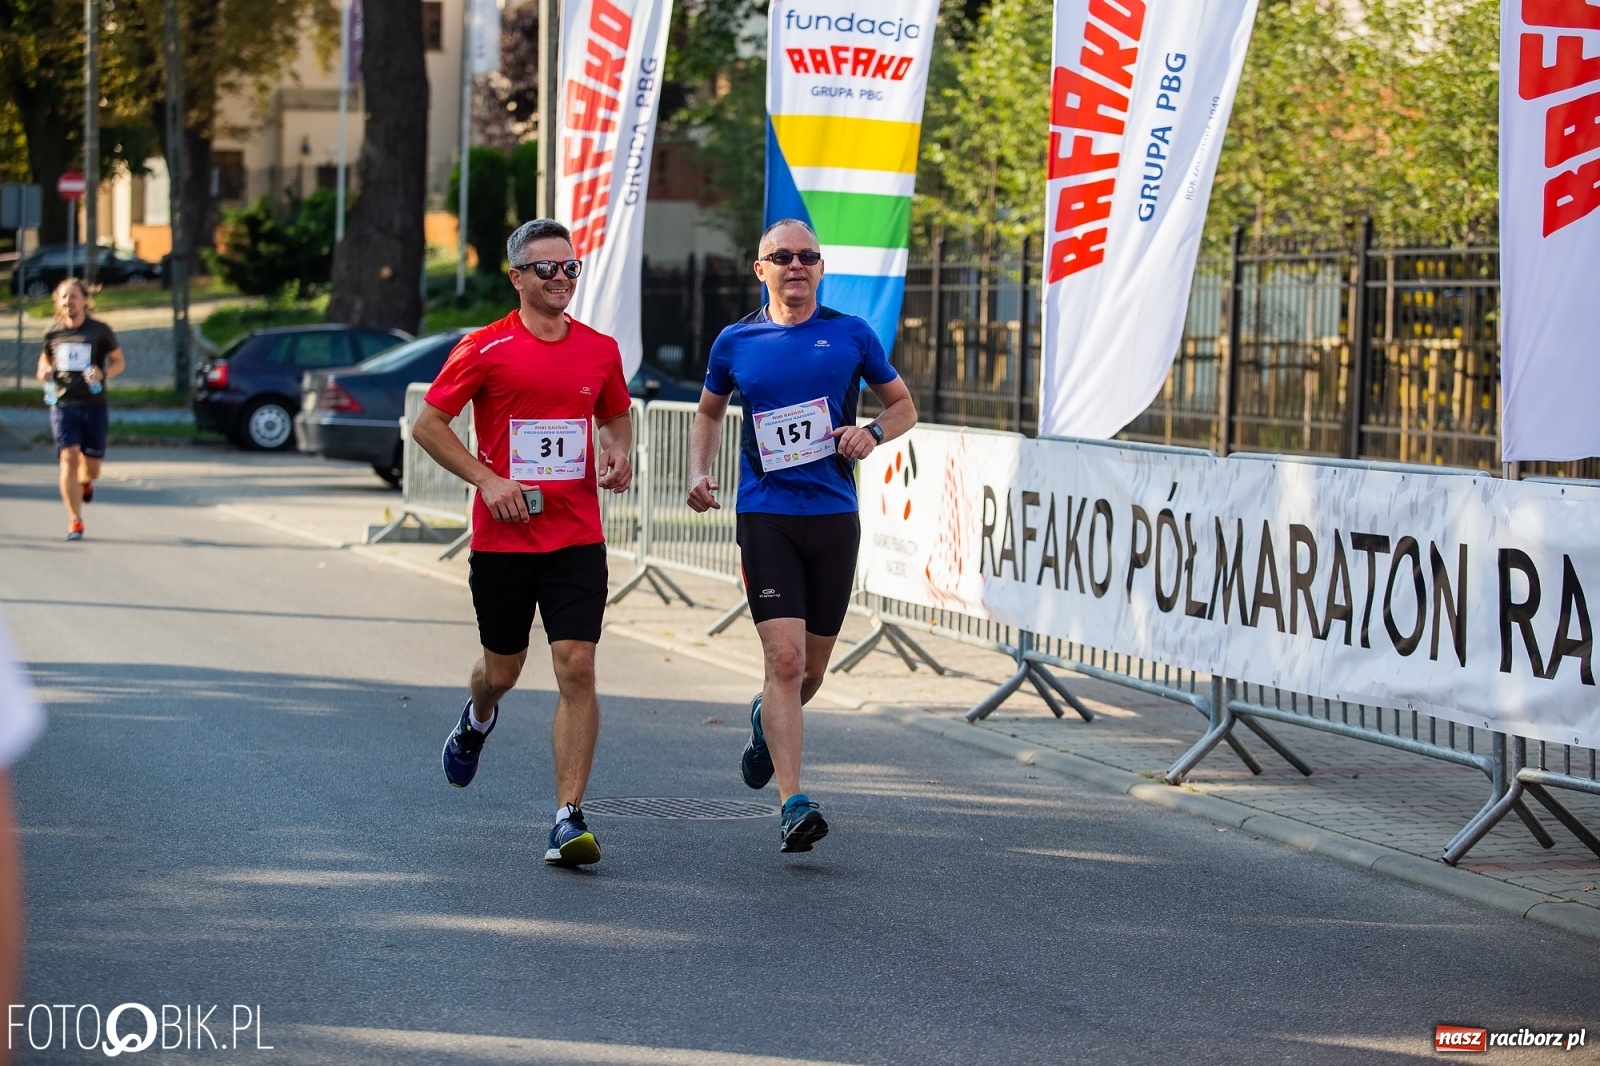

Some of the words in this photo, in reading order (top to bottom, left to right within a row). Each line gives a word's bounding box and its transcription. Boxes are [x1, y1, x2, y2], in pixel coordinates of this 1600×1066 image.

[785, 9, 921, 42] fundacja
[635, 57, 657, 108] PBG
[785, 45, 914, 81] RAFAKO
[811, 86, 854, 98] GRUPA
[860, 89, 884, 101] PBG
[563, 0, 633, 260] RAFAKO
[1047, 0, 1147, 284] RAFAKO
[1138, 126, 1173, 222] GRUPA
[1156, 52, 1188, 112] PBG
[624, 120, 651, 206] GRUPA
[540, 437, 564, 458] 31
[776, 420, 811, 446] 157
[979, 485, 1113, 599] RAFAKO
[1127, 482, 1468, 668] PÓŁMARATON
[1497, 548, 1596, 686] RA
